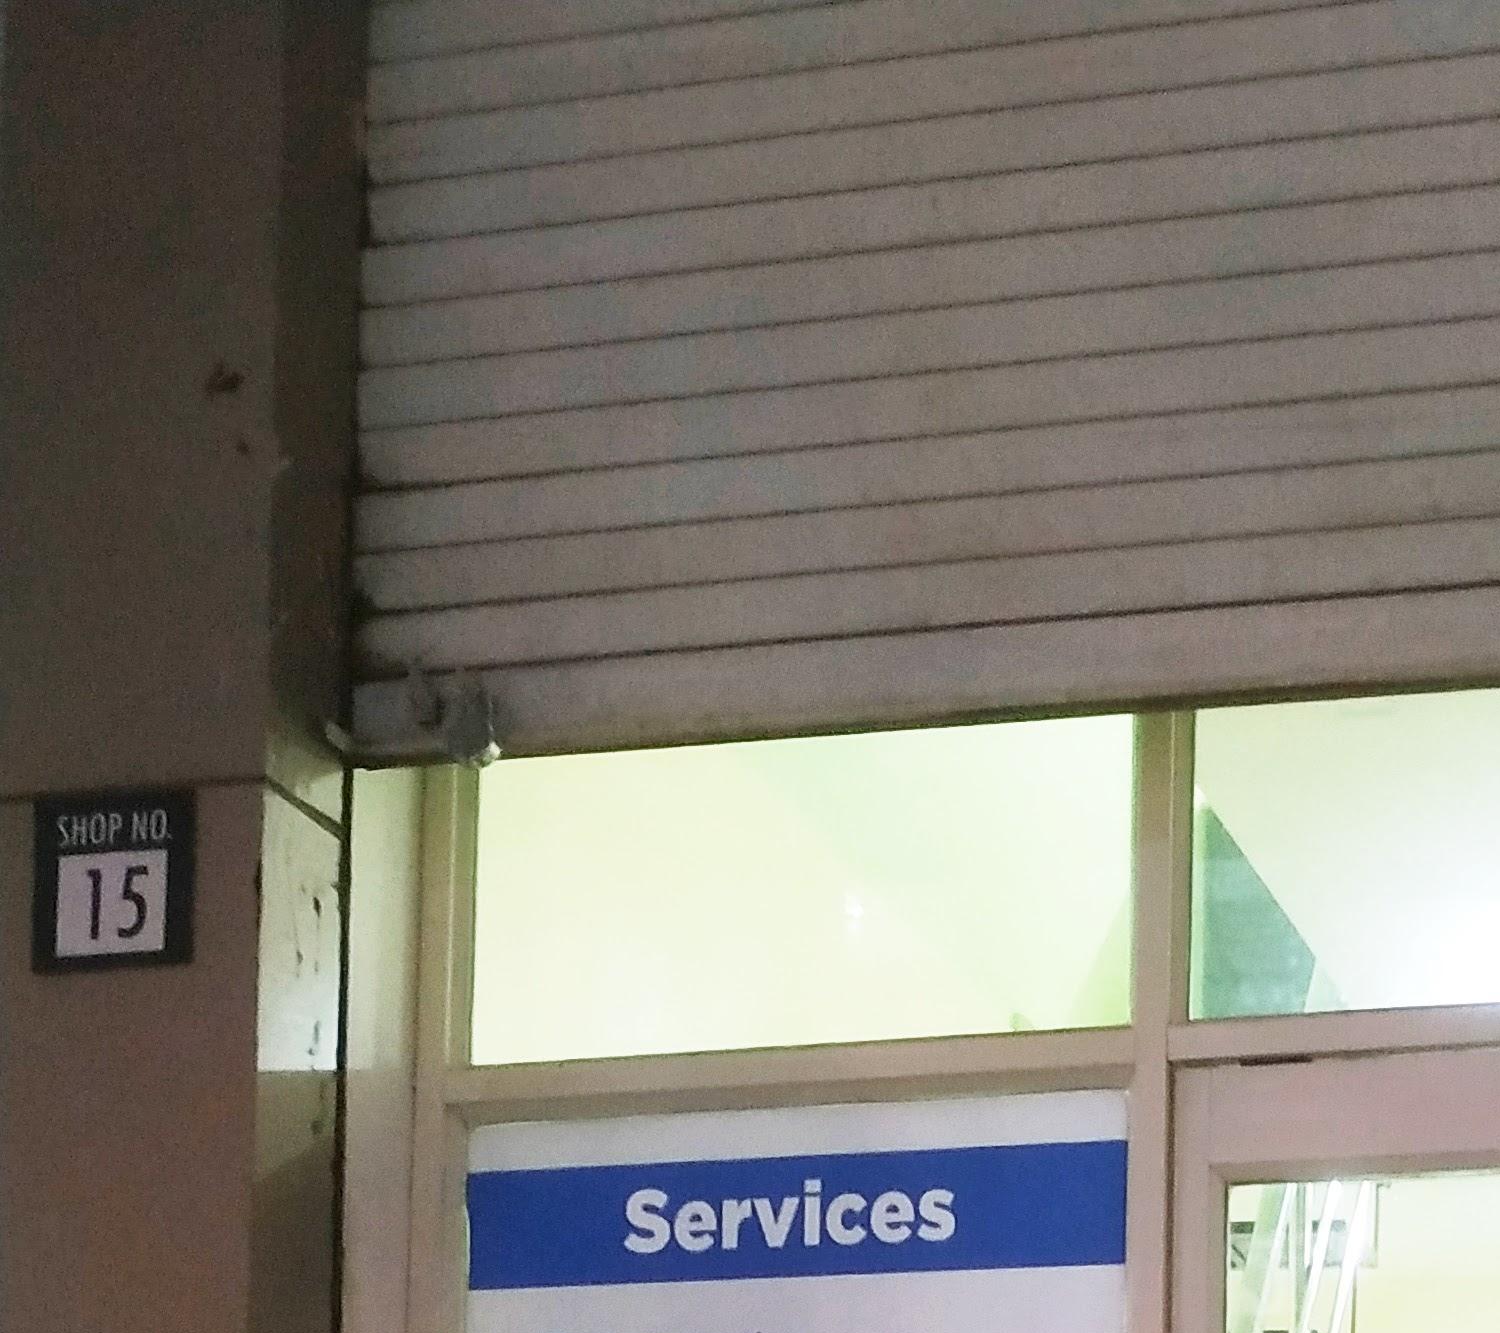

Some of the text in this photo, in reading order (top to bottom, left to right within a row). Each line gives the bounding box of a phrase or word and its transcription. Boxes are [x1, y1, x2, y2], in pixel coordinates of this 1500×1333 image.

[58, 813, 122, 846] SHOP
[88, 866, 148, 939] 15
[624, 1179, 955, 1253] Services
